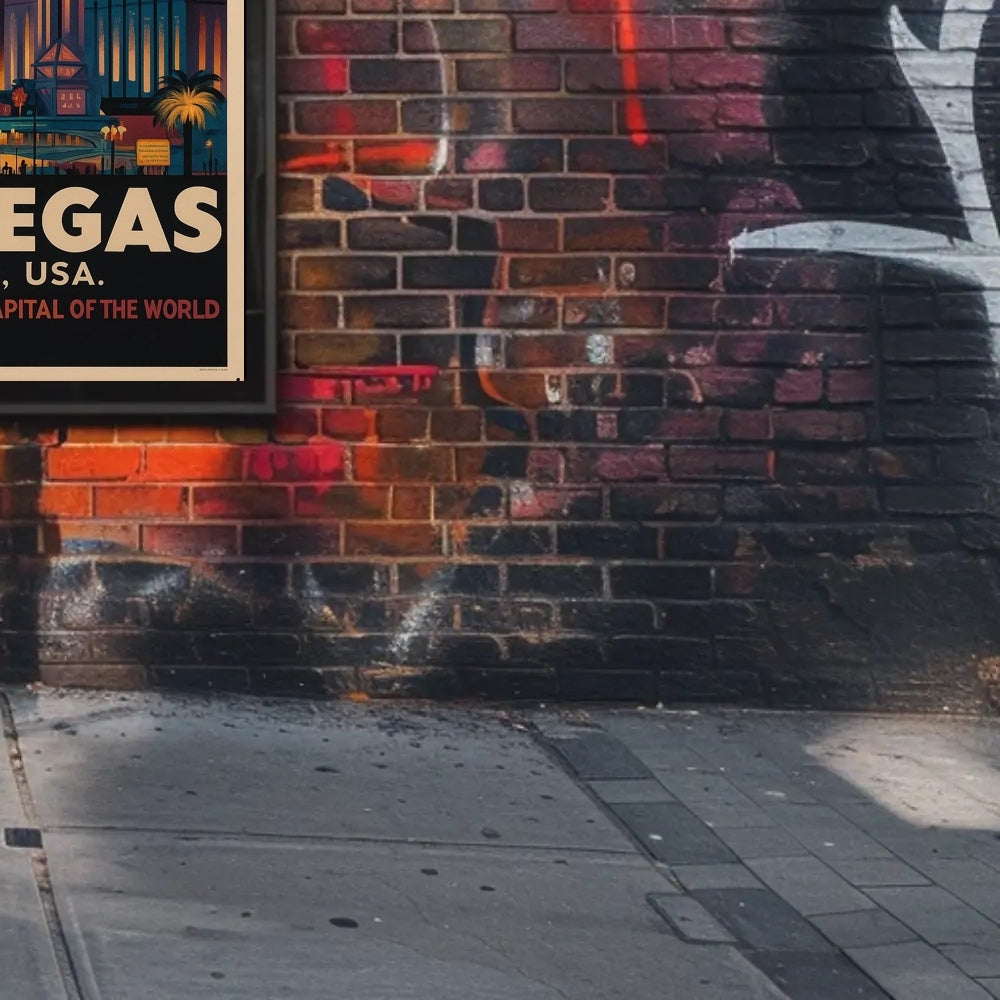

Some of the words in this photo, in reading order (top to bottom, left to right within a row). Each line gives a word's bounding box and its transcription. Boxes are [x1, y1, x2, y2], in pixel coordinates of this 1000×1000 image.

[25, 261, 105, 286] USA.
[69, 299, 97, 320] OF
[99, 299, 139, 320] THE
[143, 299, 220, 320] WORLD
